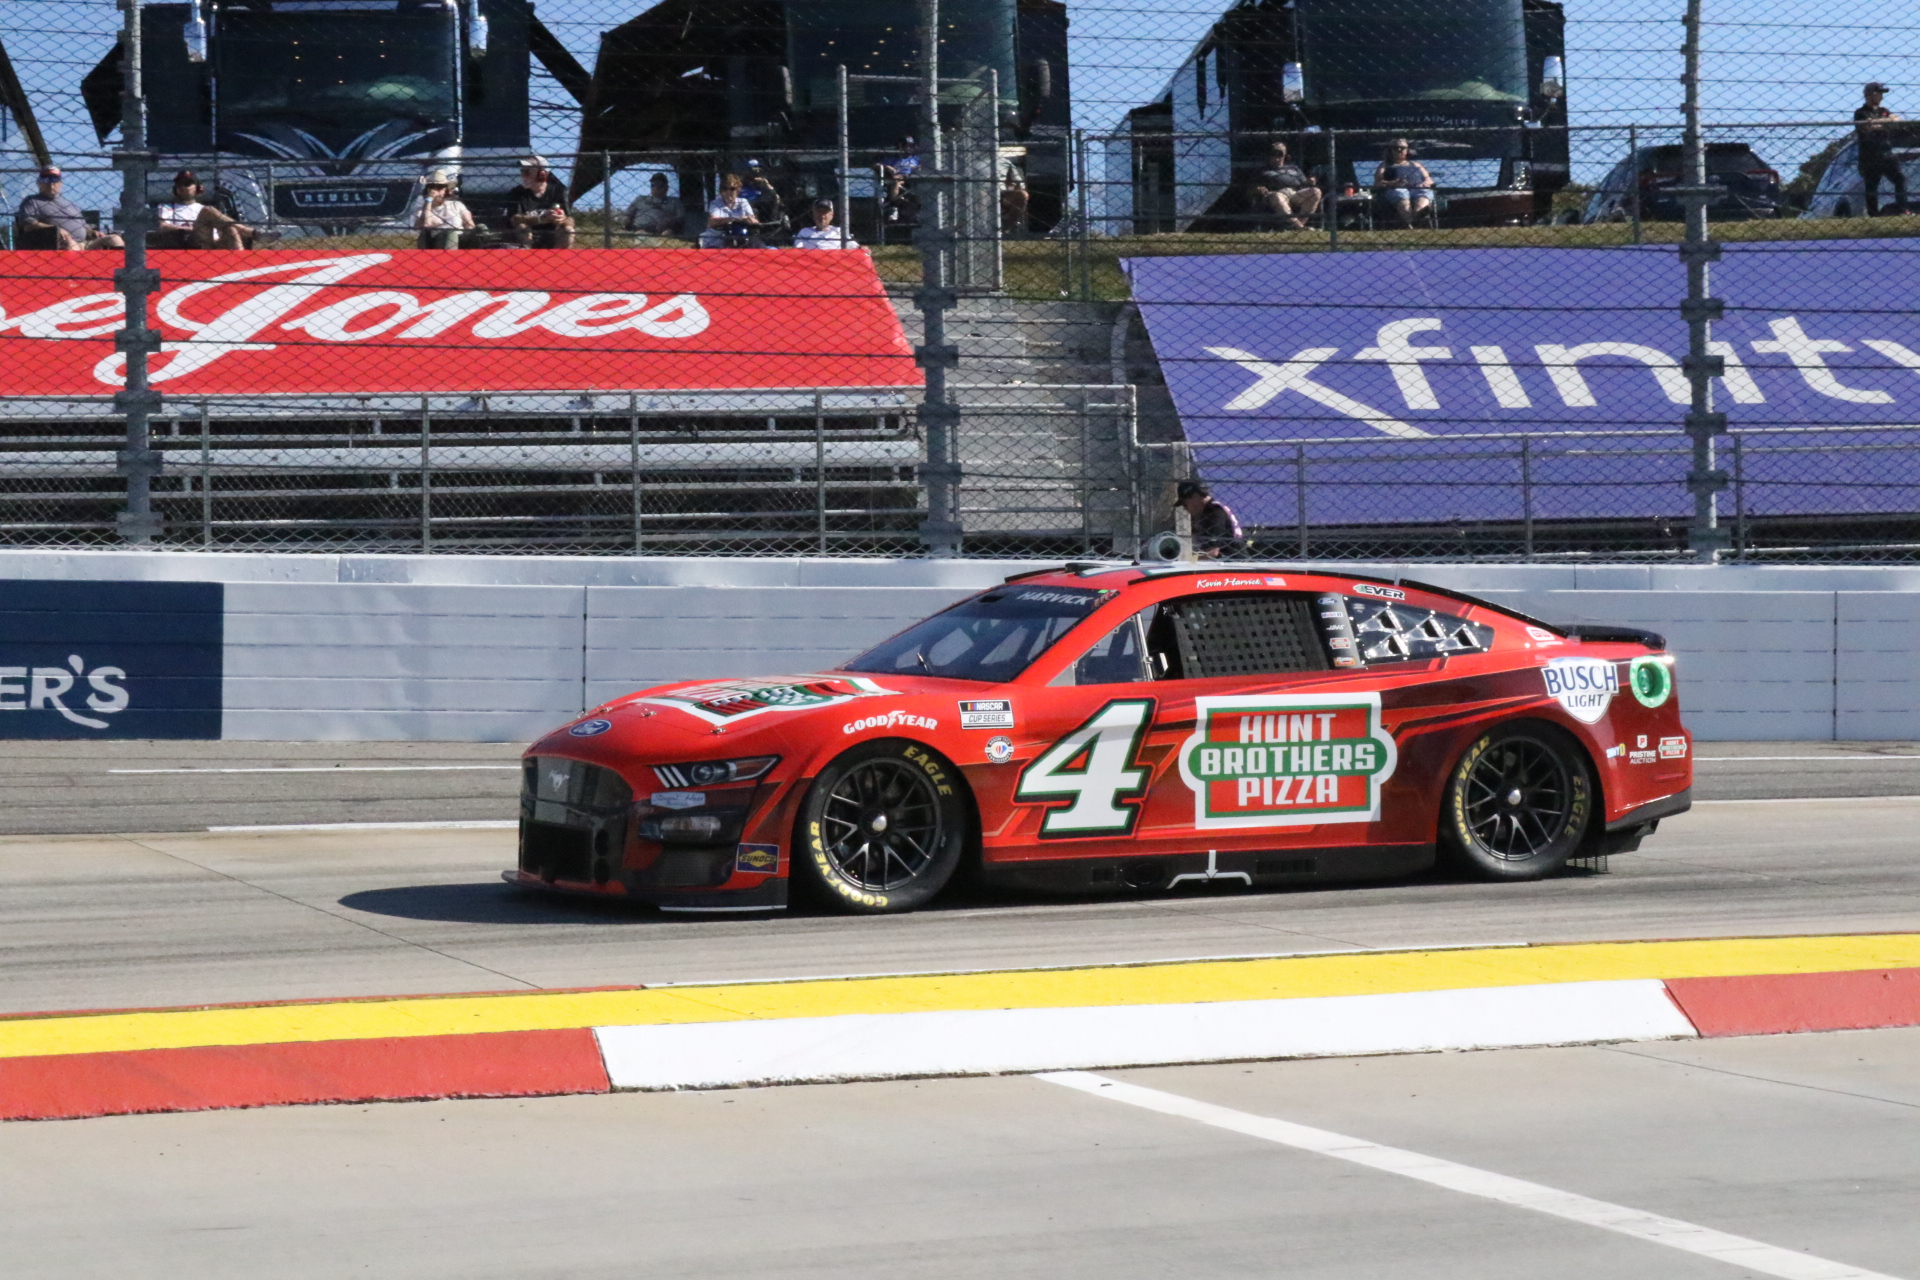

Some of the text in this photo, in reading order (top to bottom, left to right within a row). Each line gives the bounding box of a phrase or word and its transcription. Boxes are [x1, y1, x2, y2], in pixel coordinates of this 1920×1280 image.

[0, 252, 710, 387] e Jones
[1196, 577, 1263, 588] Kevin Harvick
[1016, 591, 1094, 606] HARVICK
[1544, 665, 1618, 695] BUSCH
[976, 701, 1004, 711] NASCAR
[1568, 693, 1605, 708] LIGHT
[968, 714, 1006, 723] CUP SERIES
[1239, 713, 1336, 744] HUNT
[902, 745, 953, 797] EAGLE
[1017, 700, 1151, 832] 4
[1201, 743, 1376, 776] BROTHERS
[1238, 773, 1339, 807] PIZZA
[740, 854, 777, 864] SUNOCO
